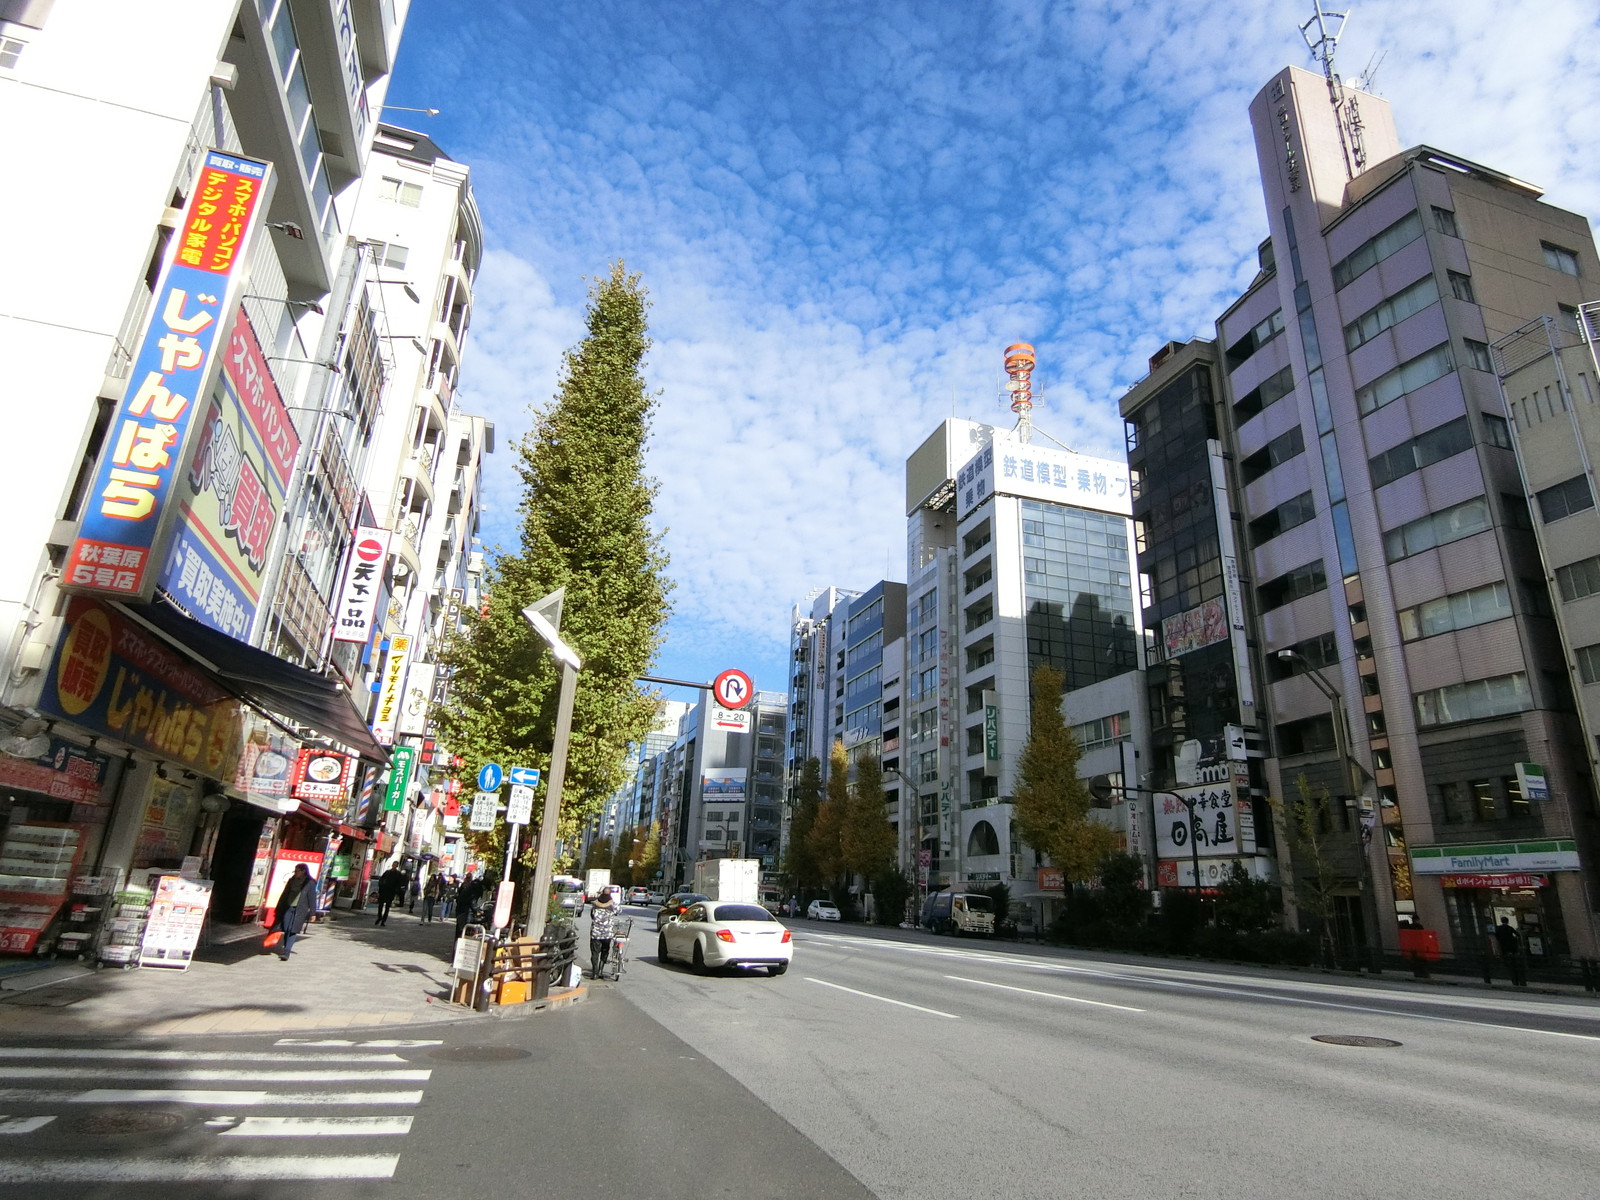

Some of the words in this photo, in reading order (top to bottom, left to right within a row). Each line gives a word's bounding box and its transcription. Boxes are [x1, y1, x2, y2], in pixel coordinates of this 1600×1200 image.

[209, 156, 264, 177] 買取・販売
[180, 171, 228, 266] デジタル家電
[210, 178, 254, 271] スマホ・パソコン
[100, 287, 219, 520] じゃんぱら
[957, 446, 994, 492] 鉄道模型
[965, 478, 986, 509] 乗物
[231, 461, 276, 567] 買取
[72, 564, 137, 590] 5号店
[78, 543, 142, 570] 秋葉原
[341, 562, 378, 629] 天下一品
[379, 654, 405, 723] マツモトキヨシ
[986, 707, 997, 759] リバティー
[391, 759, 407, 807] モスバーガー
[941, 781, 950, 831] リバティー
[1450, 856, 1510, 870] FamilyMart
